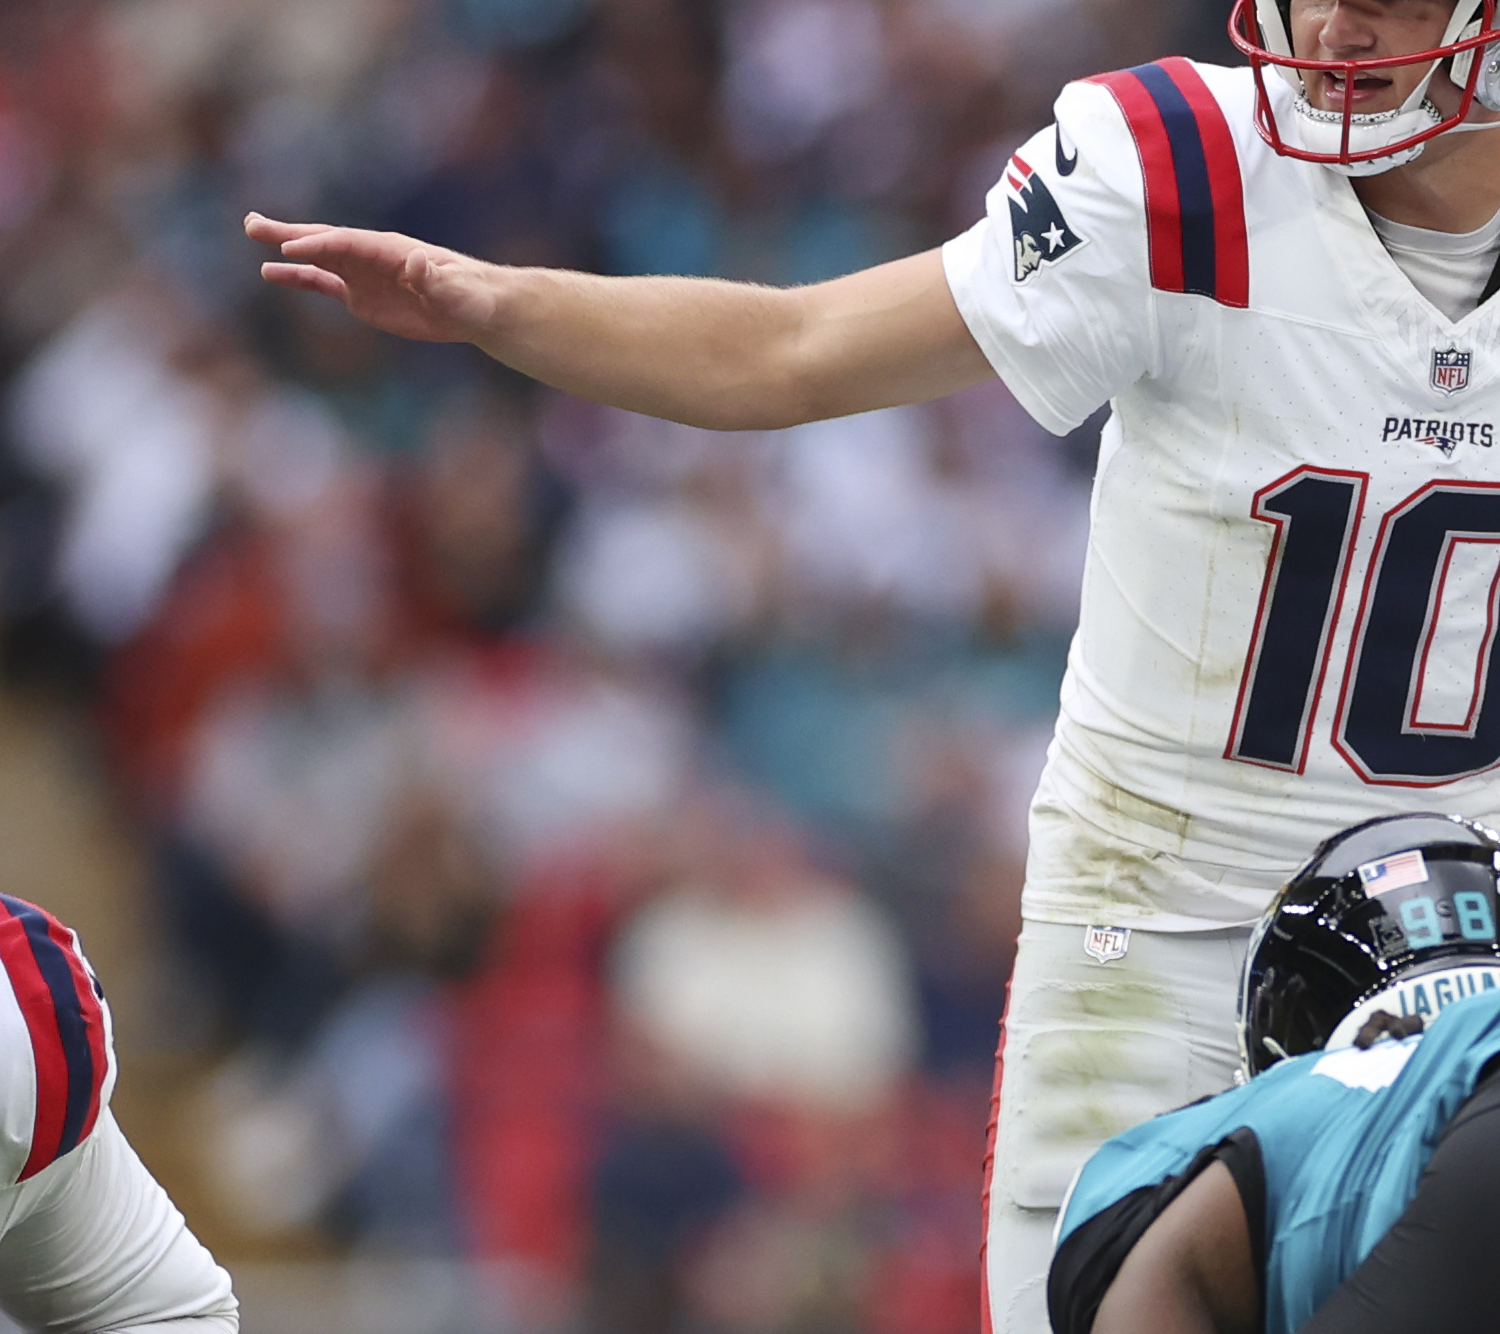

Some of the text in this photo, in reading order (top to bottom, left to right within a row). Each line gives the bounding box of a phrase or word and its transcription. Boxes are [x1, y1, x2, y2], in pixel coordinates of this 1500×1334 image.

[1436, 367, 1465, 388] NFL
[1381, 417, 1494, 448] PATRIOTS
[1400, 890, 1497, 951] 98
[1092, 932, 1120, 953] NFL
